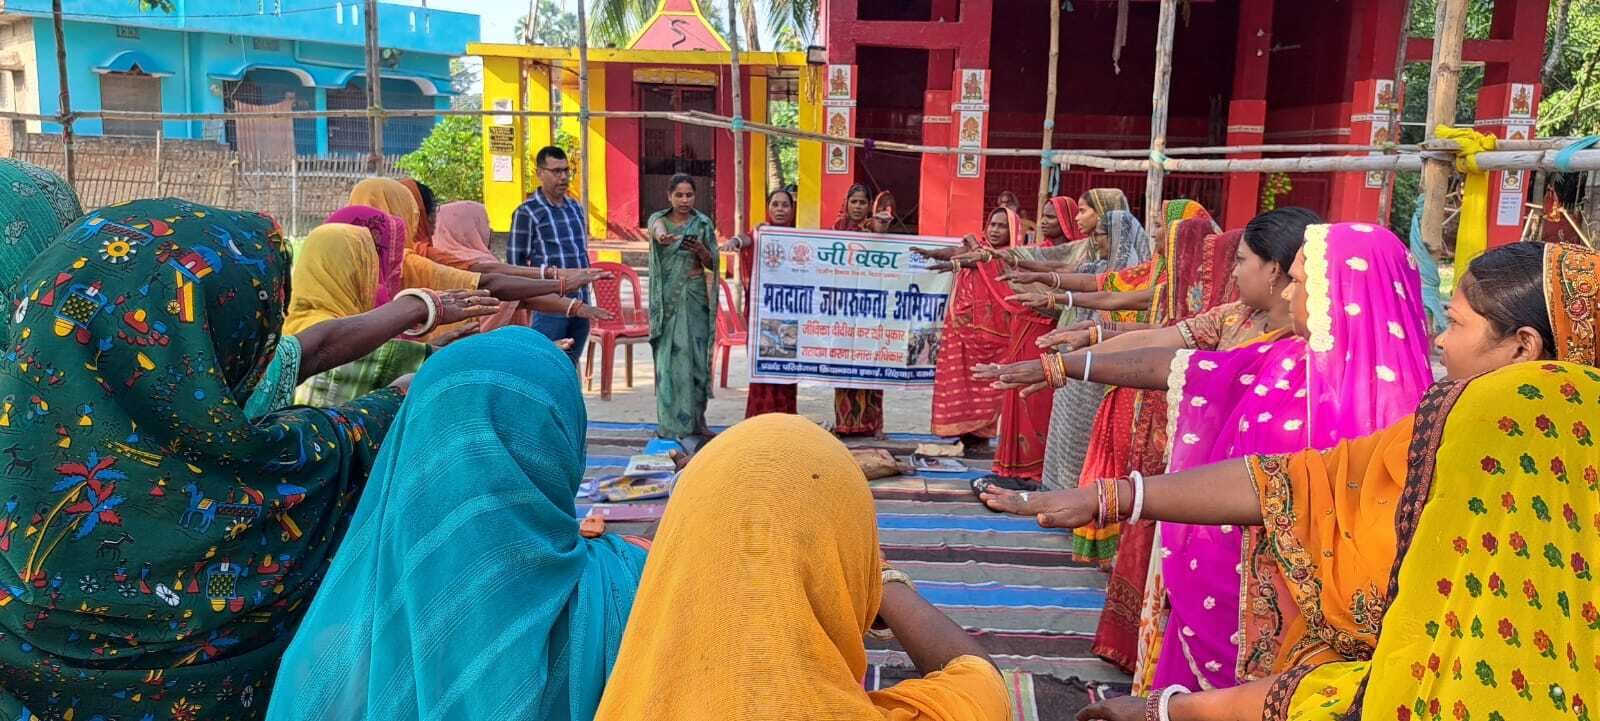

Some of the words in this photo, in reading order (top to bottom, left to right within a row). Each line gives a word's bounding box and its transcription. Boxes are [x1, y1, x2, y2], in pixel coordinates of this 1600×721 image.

[817, 241, 902, 269] जीविका
[763, 283, 814, 315] मतदाता
[893, 283, 949, 322] अभियान
[801, 320, 830, 336] जीविका
[856, 327, 871, 338] कर
[872, 323, 883, 341] रही
[884, 329, 906, 345] पुकार
